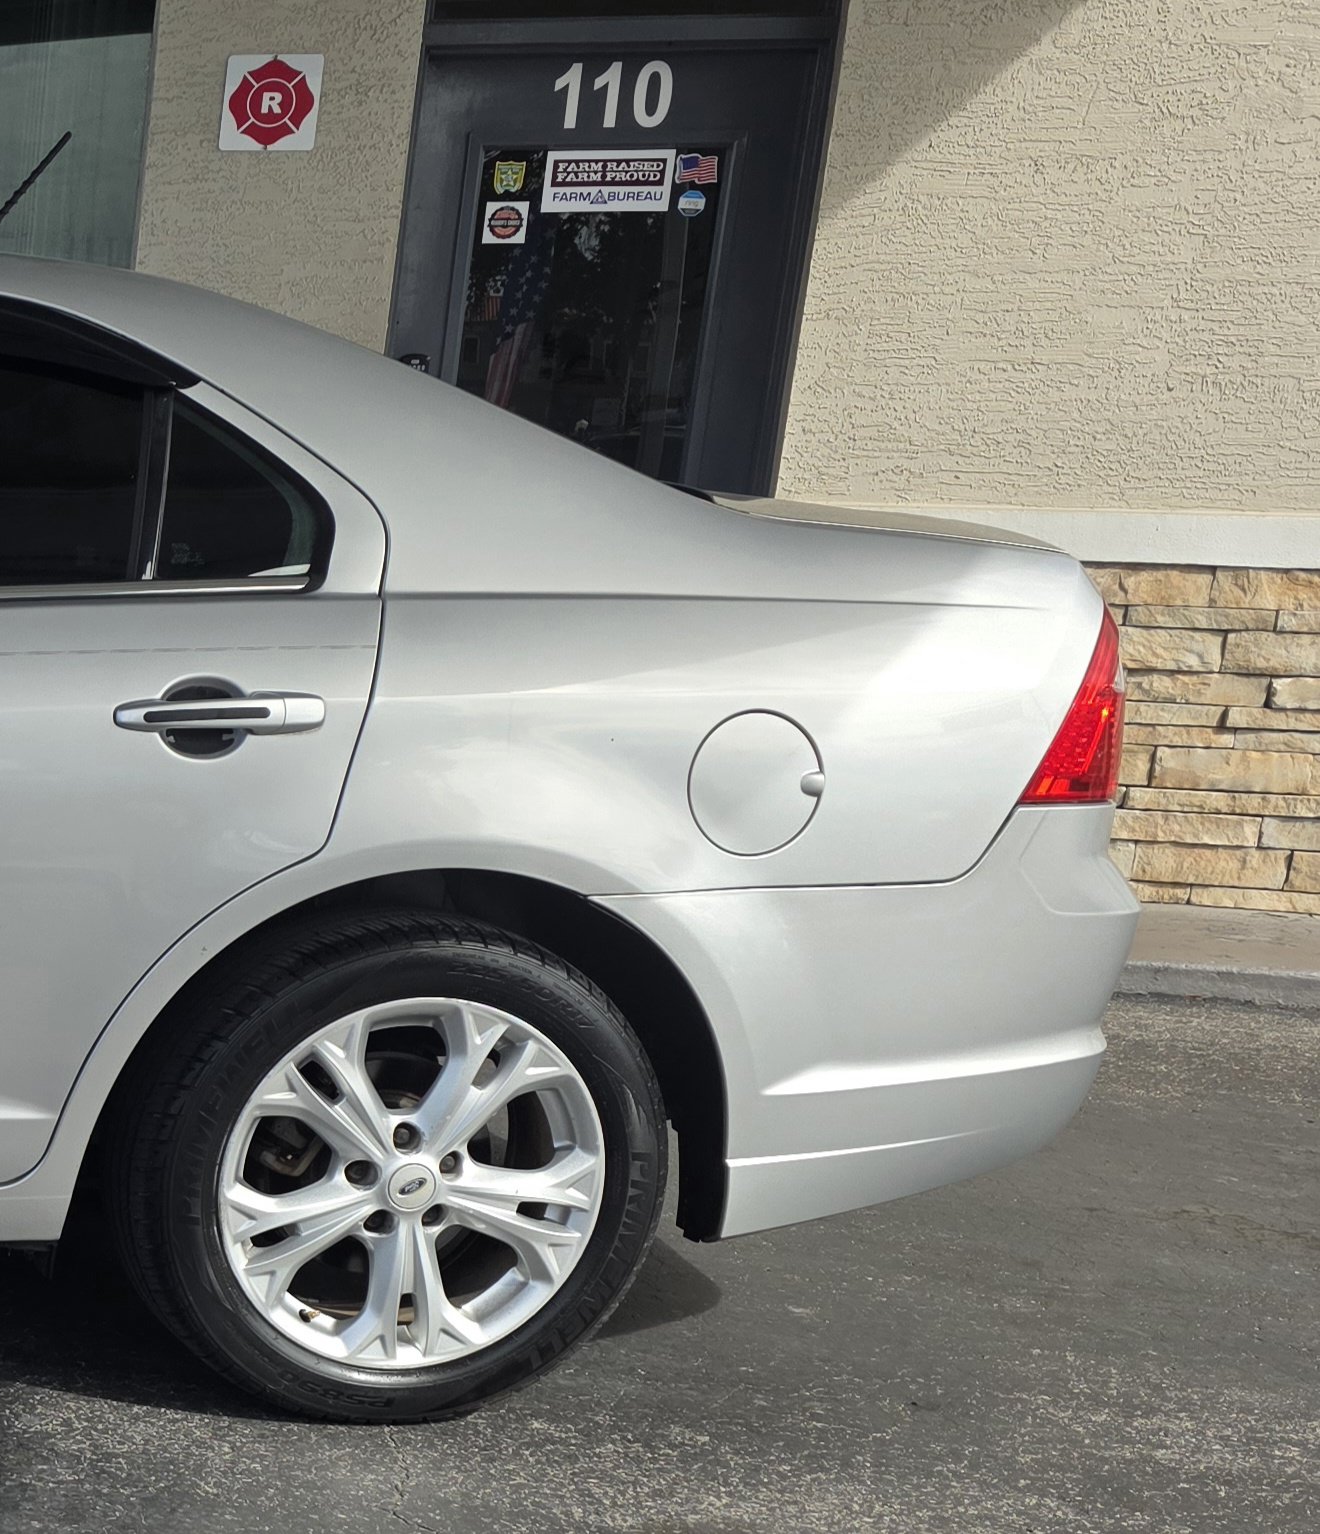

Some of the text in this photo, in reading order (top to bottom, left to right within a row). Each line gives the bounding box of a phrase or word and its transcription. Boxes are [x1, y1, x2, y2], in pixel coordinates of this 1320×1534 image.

[554, 60, 673, 129] 110
[261, 91, 282, 114] R
[558, 161, 663, 172] FARM RAISED
[556, 171, 660, 182] FARM PROUD
[552, 191, 663, 202] FARM BUREAU
